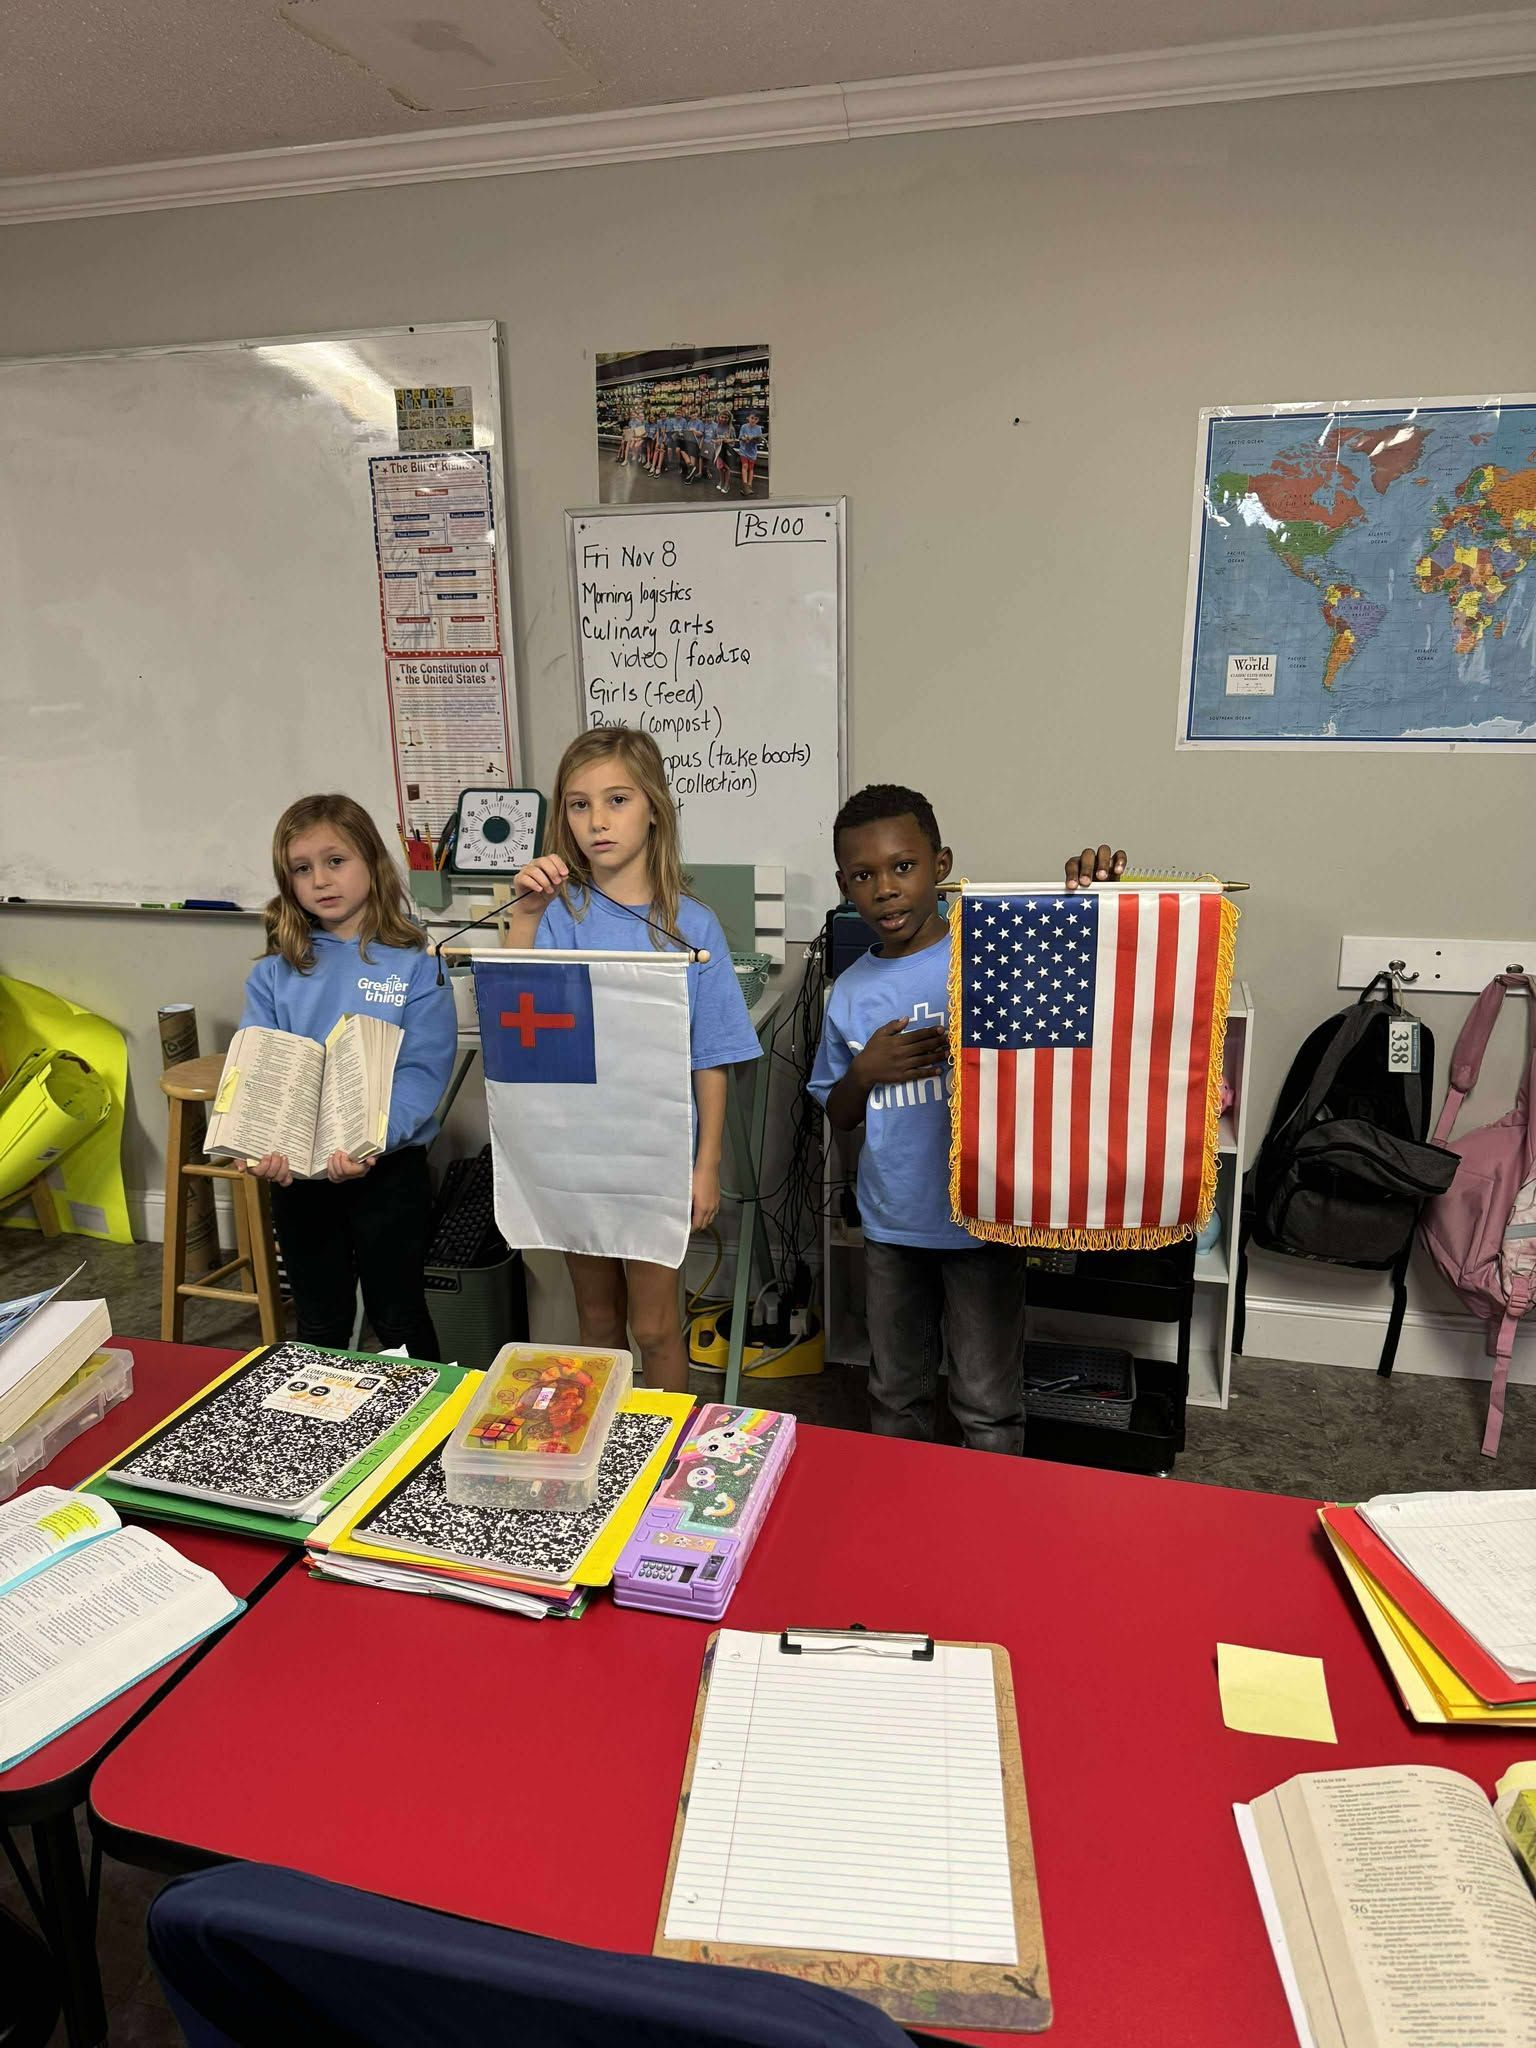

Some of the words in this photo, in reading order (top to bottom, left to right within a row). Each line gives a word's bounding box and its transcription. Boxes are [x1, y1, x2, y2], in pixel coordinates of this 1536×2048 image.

[390, 462, 408, 474] The
[411, 461, 426, 473] Bill
[428, 461, 438, 471] of
[583, 544, 609, 569] Fri
[622, 545, 655, 567] Nov
[662, 541, 677, 567] 8
[582, 582, 633, 621] Morning
[640, 577, 693, 623] logistics
[582, 616, 658, 655] Culinary
[669, 613, 714, 636] arts
[399, 664, 417, 673] The
[420, 663, 477, 673] Constitution
[479, 662, 489, 673] of
[611, 643, 668, 668] video
[1234, 656, 1269, 671] World
[405, 675, 420, 684] the
[422, 674, 454, 684] United
[456, 673, 487, 684] States
[589, 677, 638, 705] Girls
[644, 679, 703, 711] (feed)
[640, 706, 722, 743] (compost)
[708, 741, 758, 768] (take
[762, 743, 811, 767] boots)
[676, 769, 757, 798] collection)
[357, 974, 409, 994] Greater
[1391, 1030, 1410, 1064] 338
[300, 1372, 321, 1381] BOOK
[306, 1366, 355, 1383] COMPOSITION
[326, 1447, 383, 1495] HELEN
[388, 1406, 431, 1439] YOON
[1457, 1884, 1473, 1895] 97
[1350, 1904, 1369, 1914] 96
